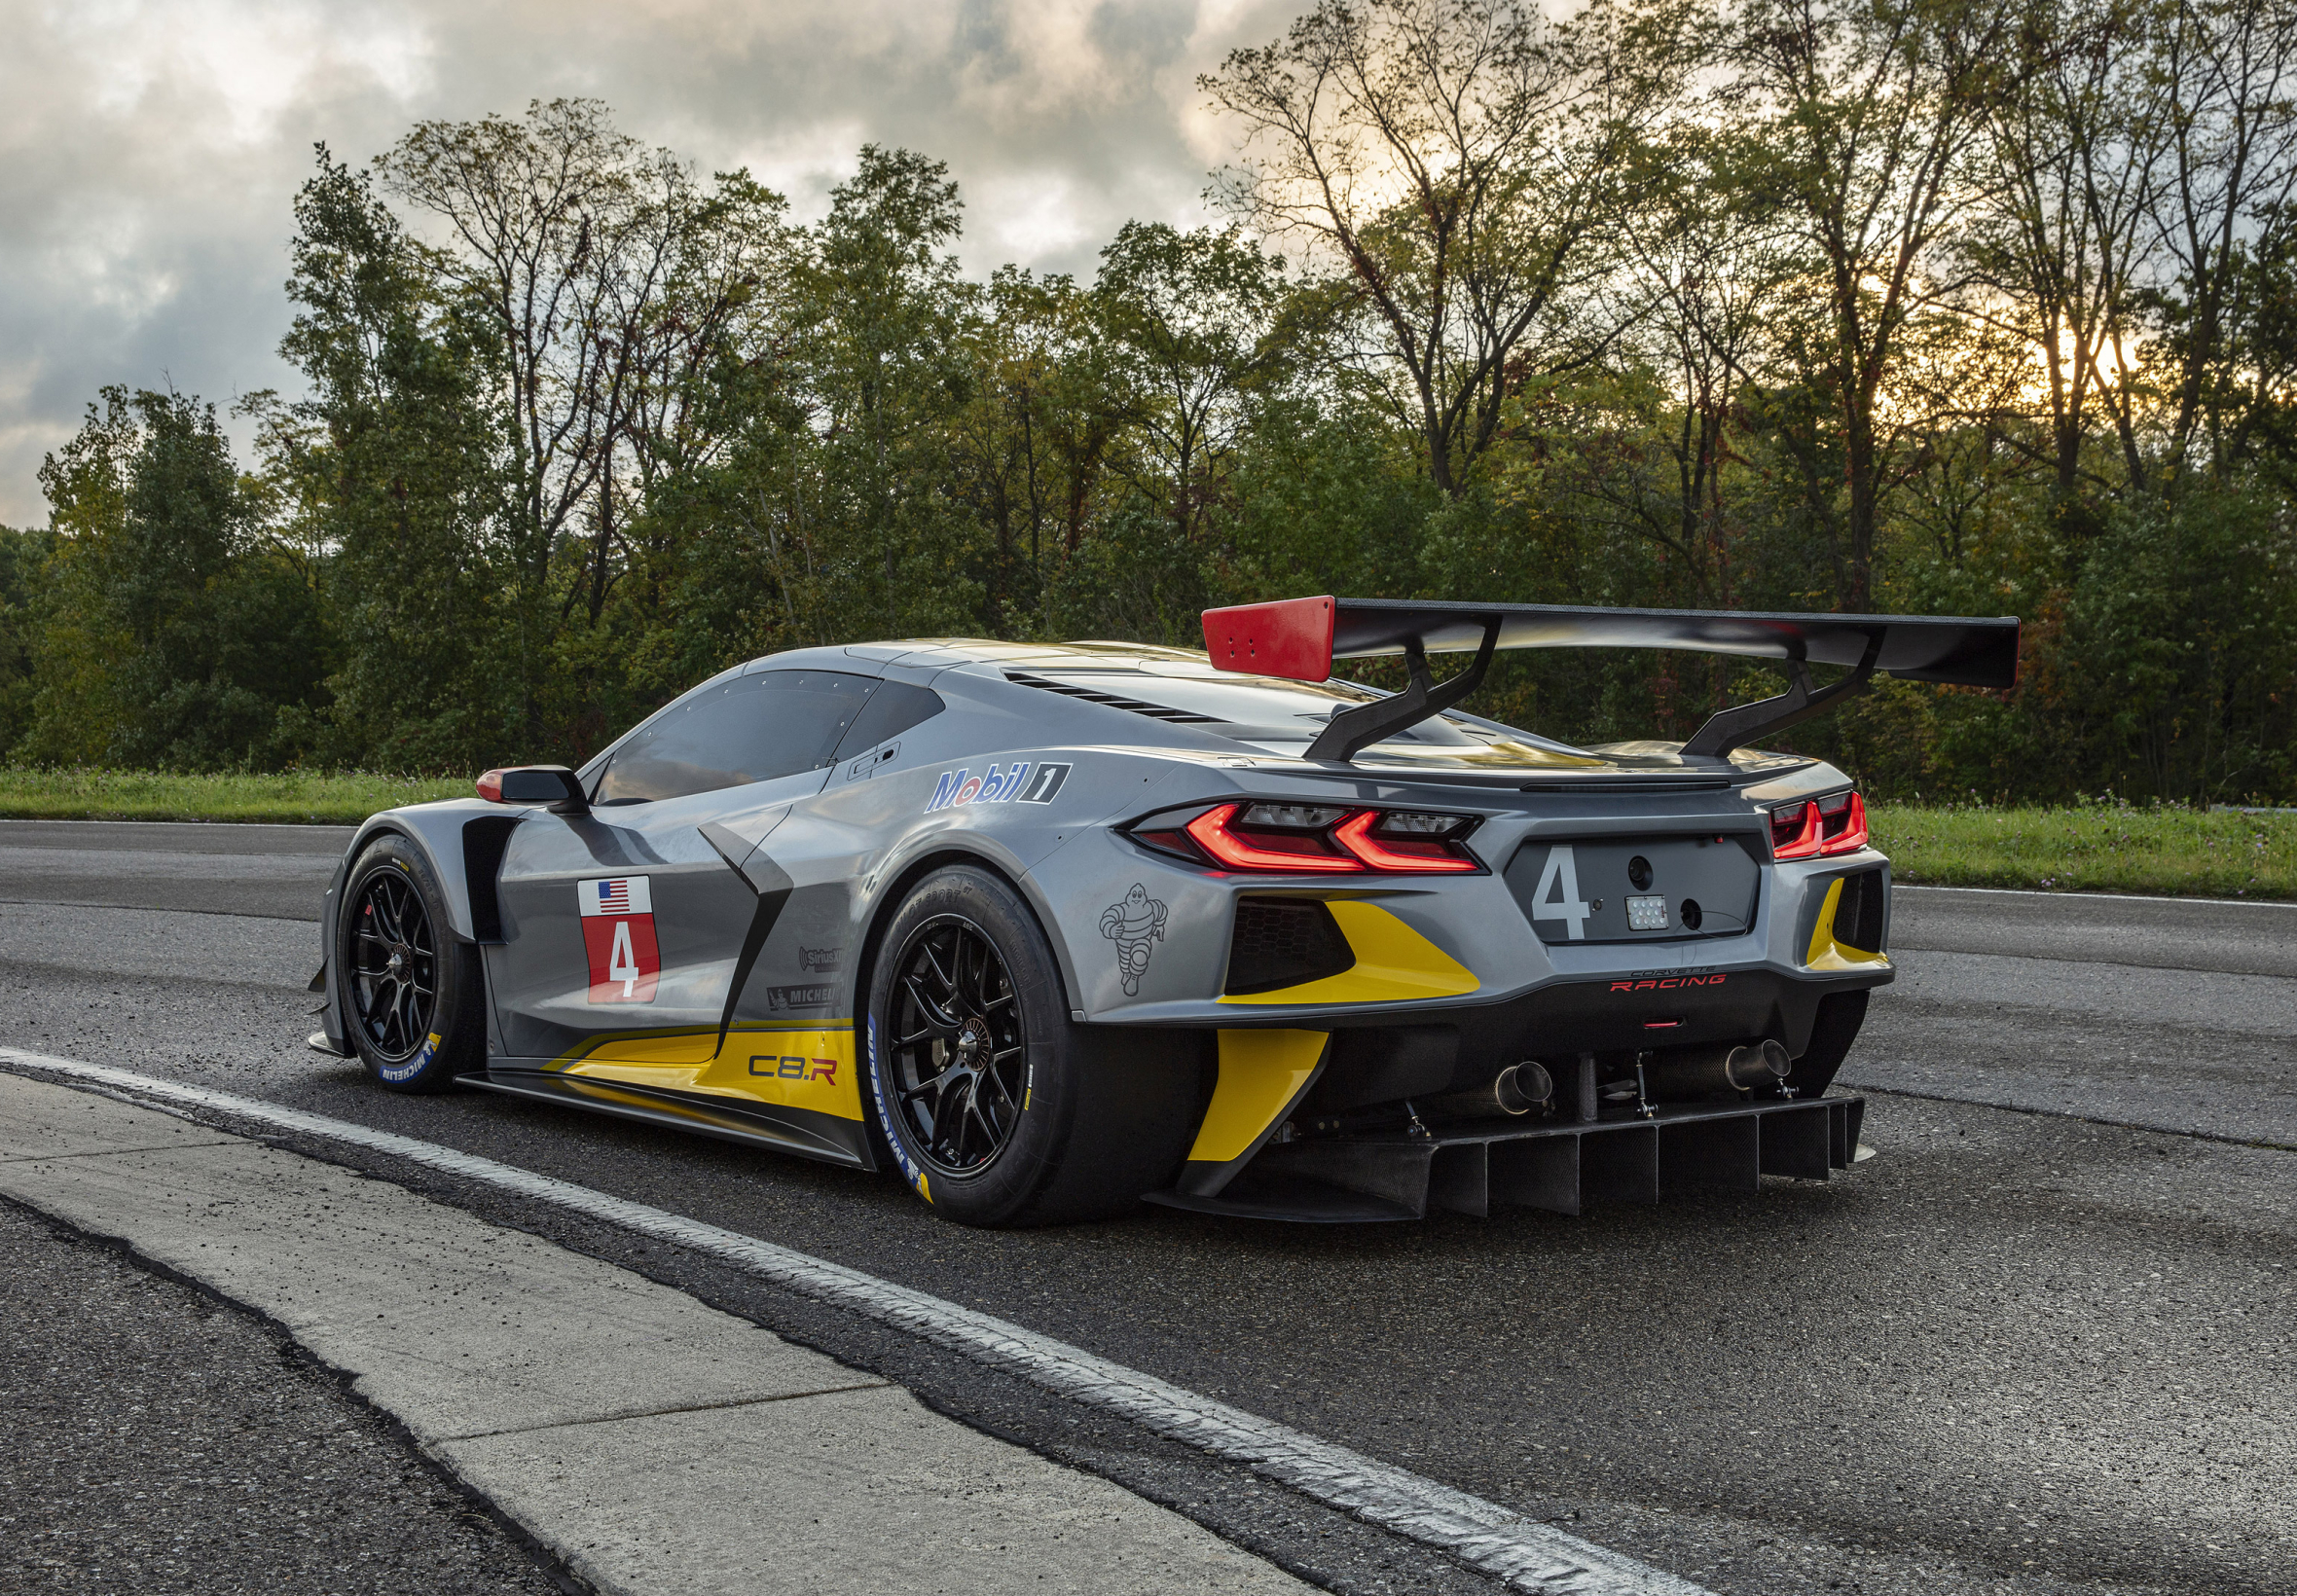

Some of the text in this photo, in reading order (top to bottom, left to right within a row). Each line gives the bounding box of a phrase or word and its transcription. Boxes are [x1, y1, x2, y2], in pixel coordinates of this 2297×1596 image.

[924, 762, 1058, 814] Mobil 1
[926, 889, 962, 907] SPORT
[1531, 844, 1591, 940] 4
[608, 921, 639, 998] 4
[1630, 965, 1717, 977] CORVETTE
[1610, 974, 1727, 992] RACING
[383, 1053, 426, 1081] MICHELIN
[748, 1055, 837, 1086] C8.R
[867, 1024, 905, 1165] MICHELIN
